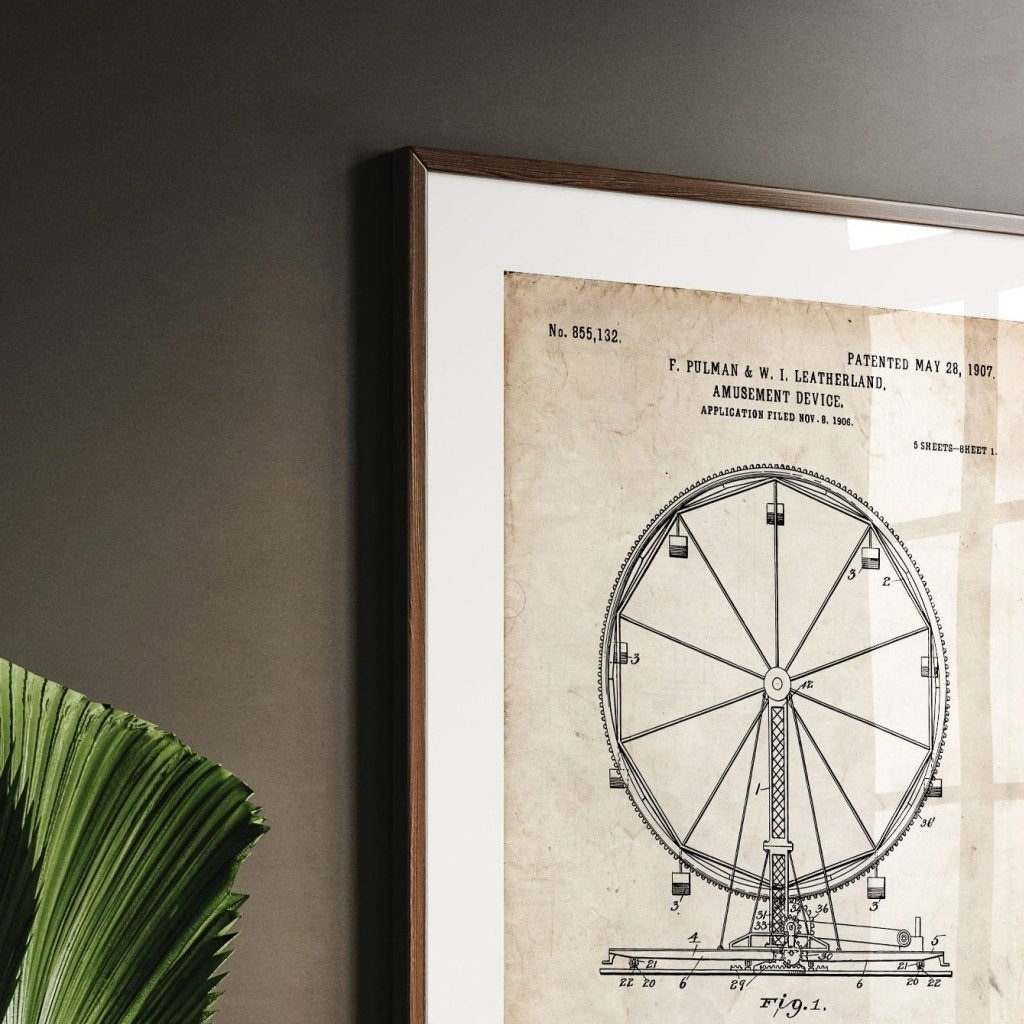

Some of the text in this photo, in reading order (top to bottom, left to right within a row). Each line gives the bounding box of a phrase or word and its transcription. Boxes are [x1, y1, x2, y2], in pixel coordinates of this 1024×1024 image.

[548, 323, 622, 344] No. 855,132.
[669, 358, 680, 372] F.
[686, 359, 739, 378] PULMAN
[744, 365, 753, 378] &
[759, 366, 774, 380] W.
[779, 368, 788, 382] I.
[847, 352, 996, 380] PATENTED MAY 28, 1907.
[712, 385, 844, 408] AMUSEMENT DEVICE.
[701, 405, 763, 420] APPLICATION
[767, 410, 795, 422] FILED
[832, 416, 854, 427] 1906.
[913, 440, 919, 450] 5
[847, 568, 857, 580] 3
[816, 903, 829, 914] 36
[619, 978, 634, 987] 22
